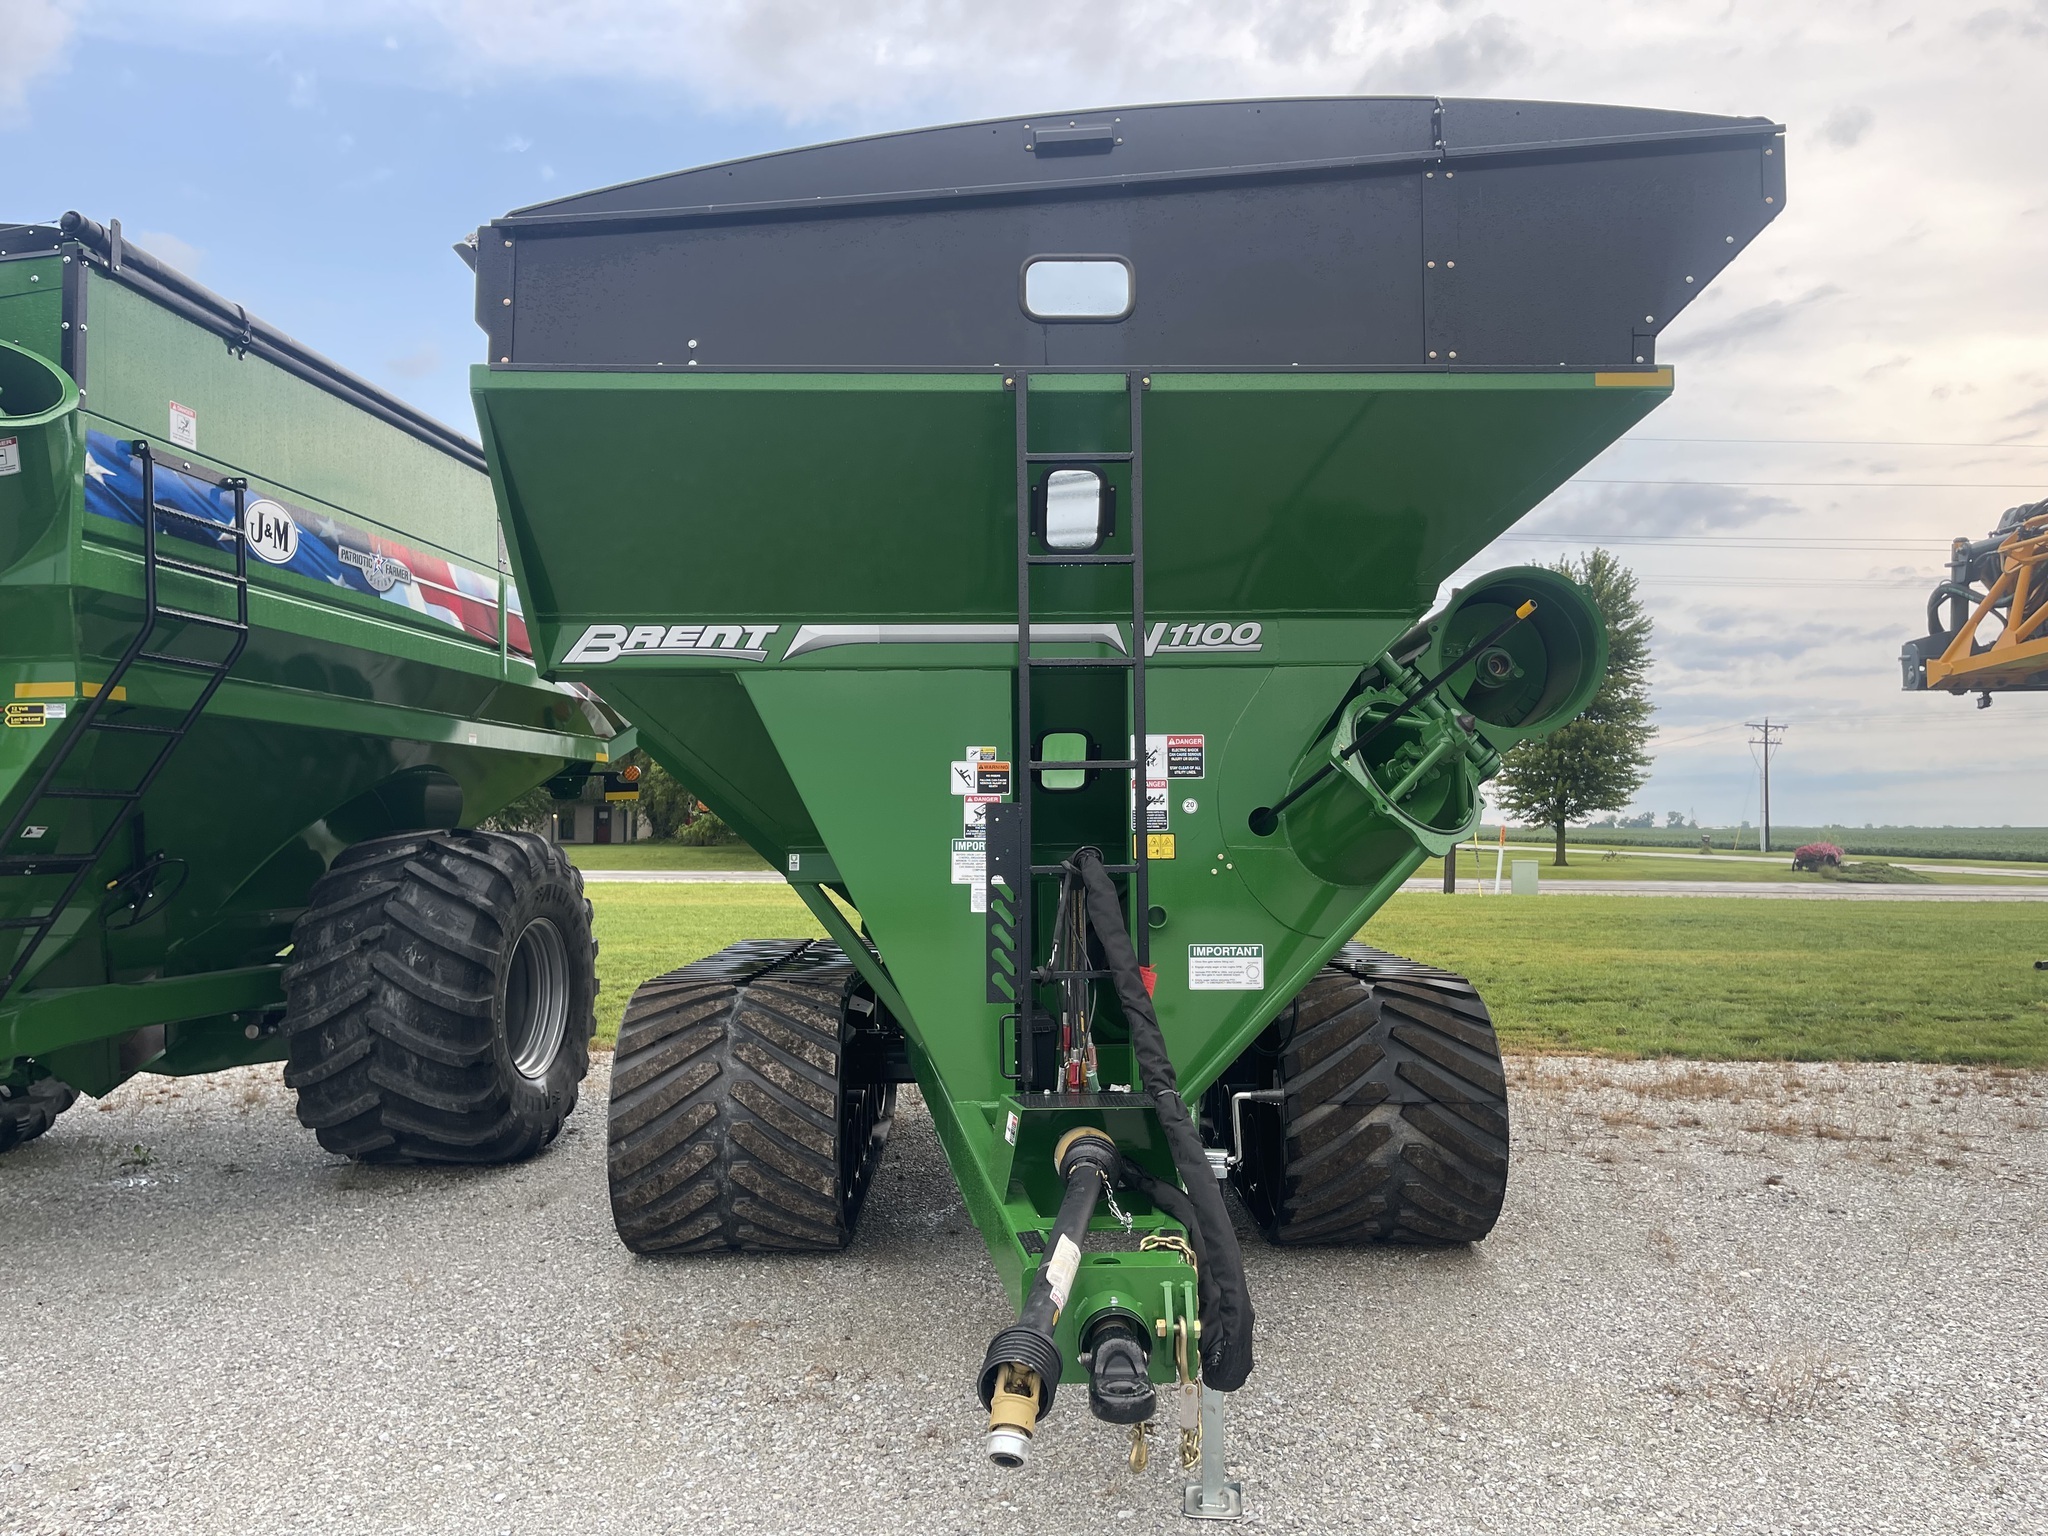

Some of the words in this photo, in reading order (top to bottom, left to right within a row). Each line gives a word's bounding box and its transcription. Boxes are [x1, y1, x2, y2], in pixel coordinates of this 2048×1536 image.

[250, 511, 290, 553] J&M
[340, 548, 373, 569] PATRIOTIC
[385, 563, 409, 581] FARMER
[560, 624, 781, 663] BRENT
[955, 841, 986, 851] IMPOR
[1193, 946, 1259, 956] IMPORTANT
